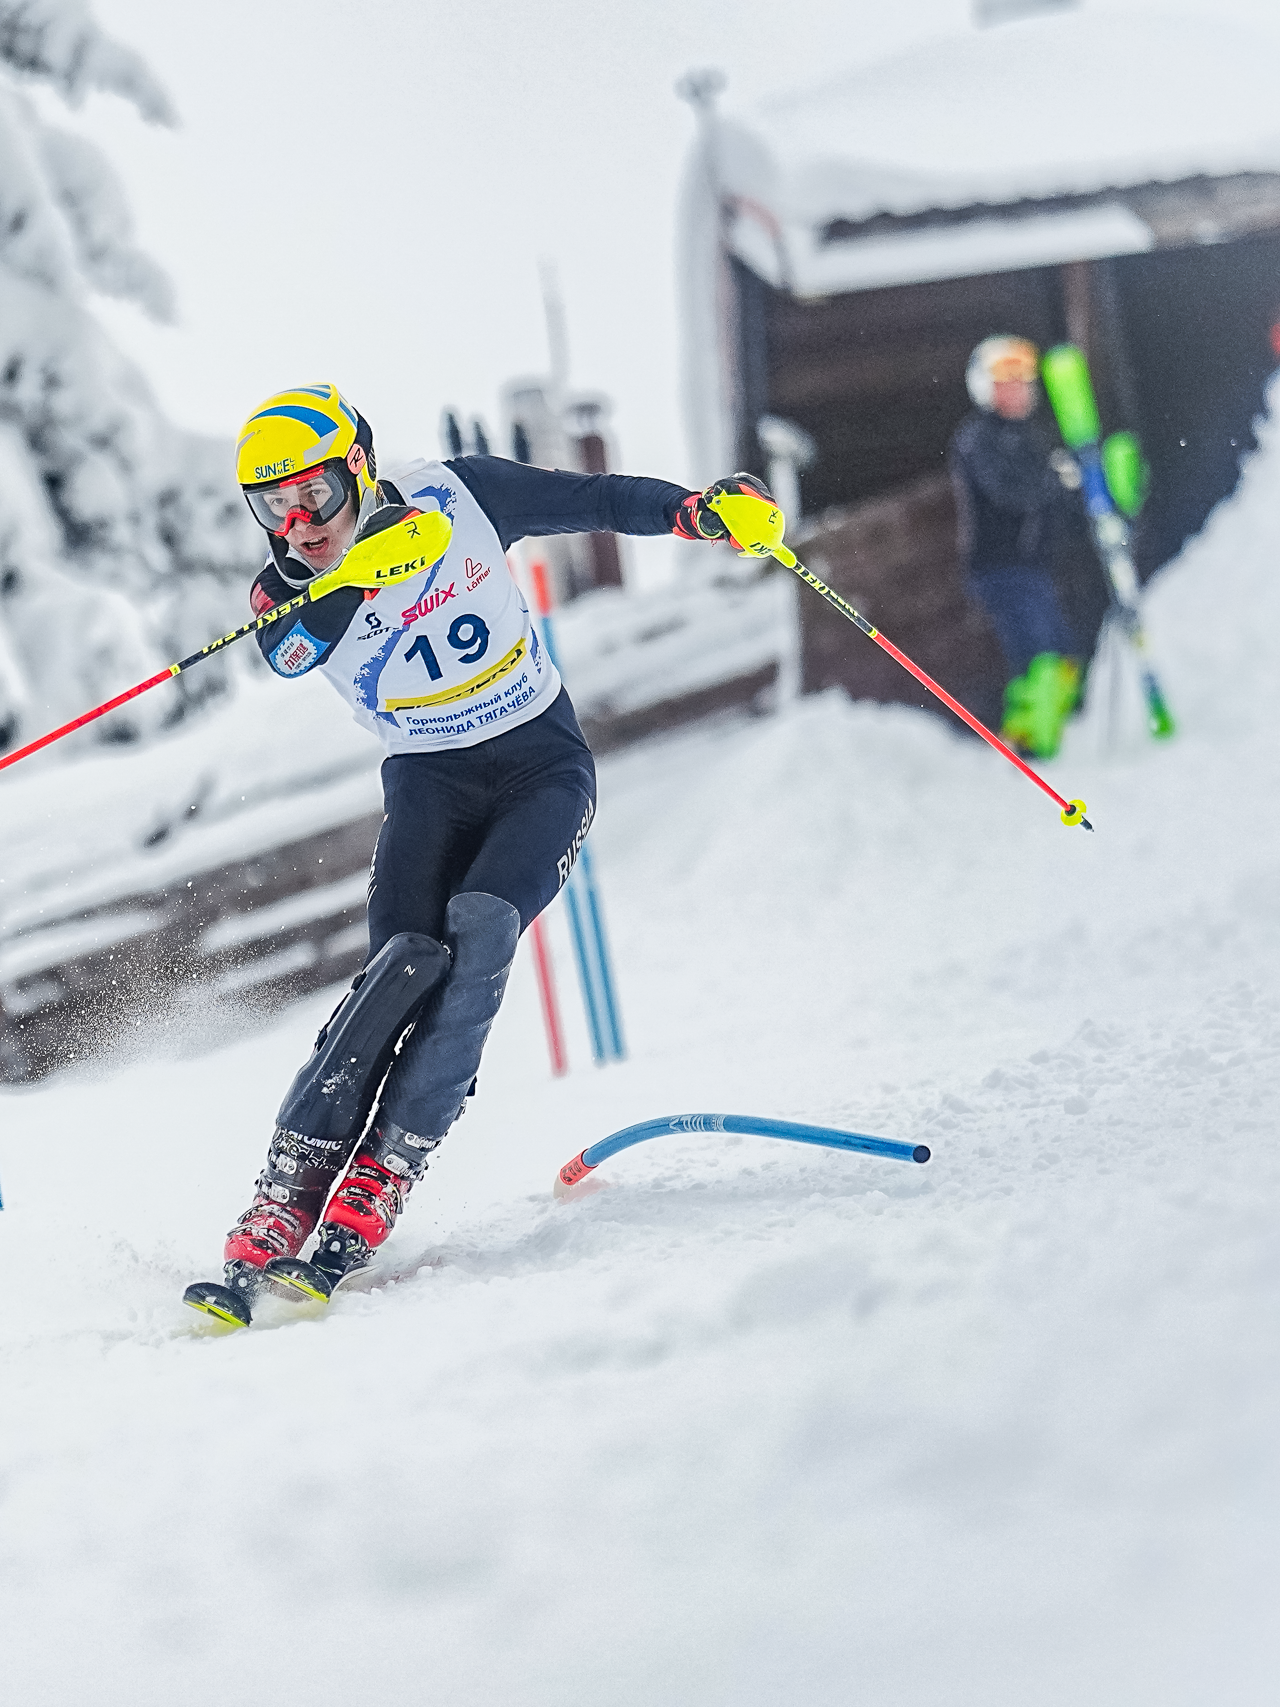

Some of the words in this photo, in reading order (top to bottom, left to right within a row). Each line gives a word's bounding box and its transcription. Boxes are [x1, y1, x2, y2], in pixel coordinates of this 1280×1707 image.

[375, 556, 426, 579] LEKI
[404, 613, 490, 681] 19
[406, 693, 502, 726] Горнолыжный
[503, 672, 528, 699] клуб
[408, 720, 476, 736] ЛЕОНИДА
[475, 685, 536, 726] ТЯГАЧЁВА
